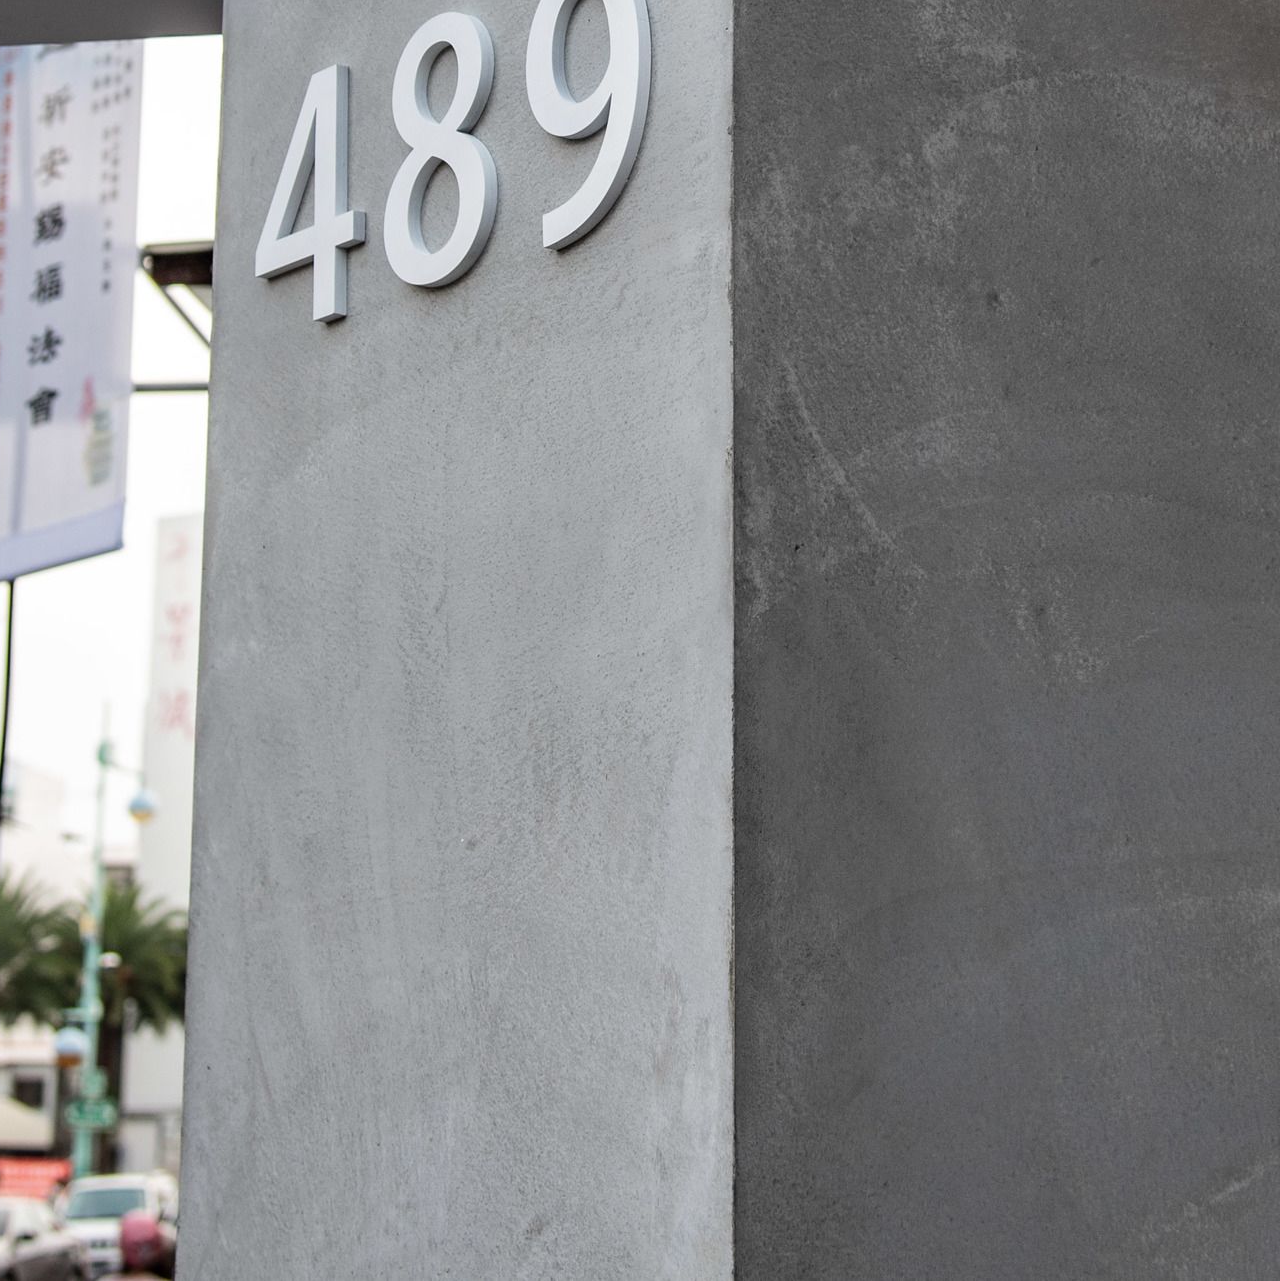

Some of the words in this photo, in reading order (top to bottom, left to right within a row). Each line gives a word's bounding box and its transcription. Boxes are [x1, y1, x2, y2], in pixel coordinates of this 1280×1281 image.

[24, 44, 77, 428] 祈安賜福法會
